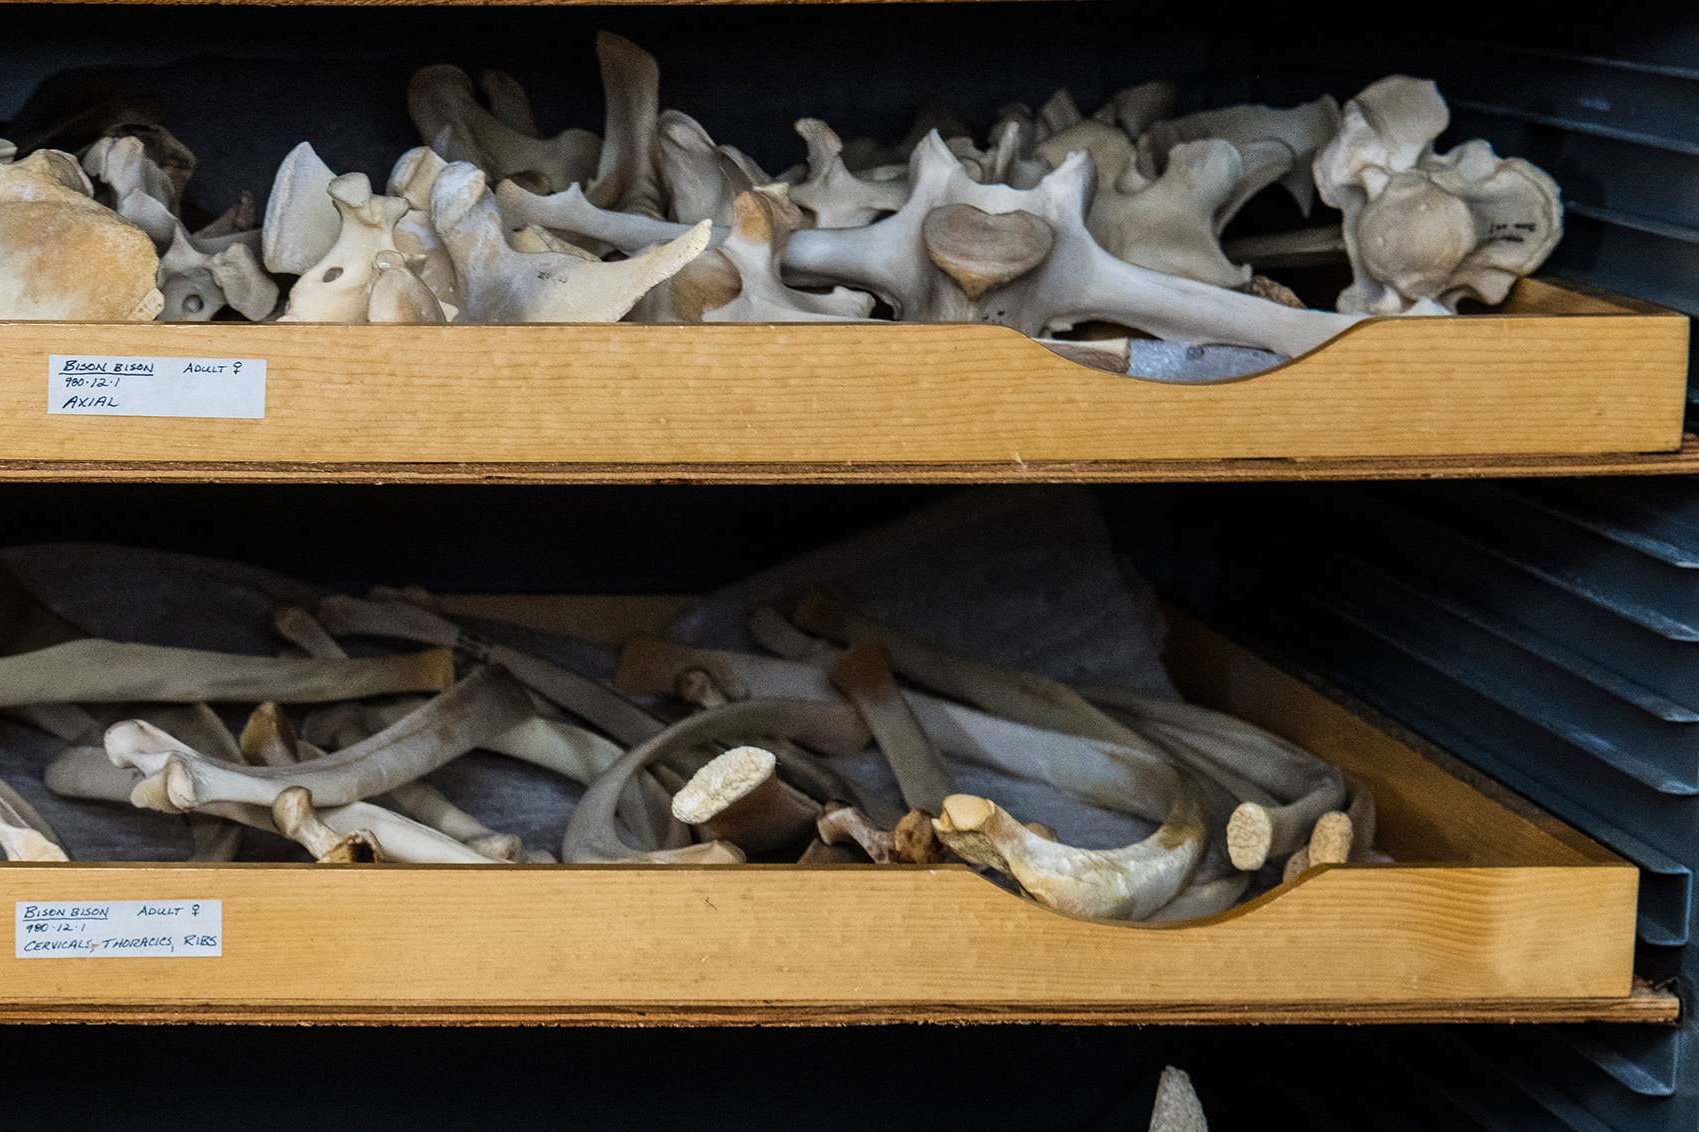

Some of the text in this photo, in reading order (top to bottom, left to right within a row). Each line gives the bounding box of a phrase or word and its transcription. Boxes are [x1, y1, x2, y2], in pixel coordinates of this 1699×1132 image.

[63, 360, 228, 373] BISON BISON ADULT
[62, 396, 119, 409] AXIAL
[23, 905, 184, 918] BISON BISON ADULT
[183, 935, 217, 946] RIBS
